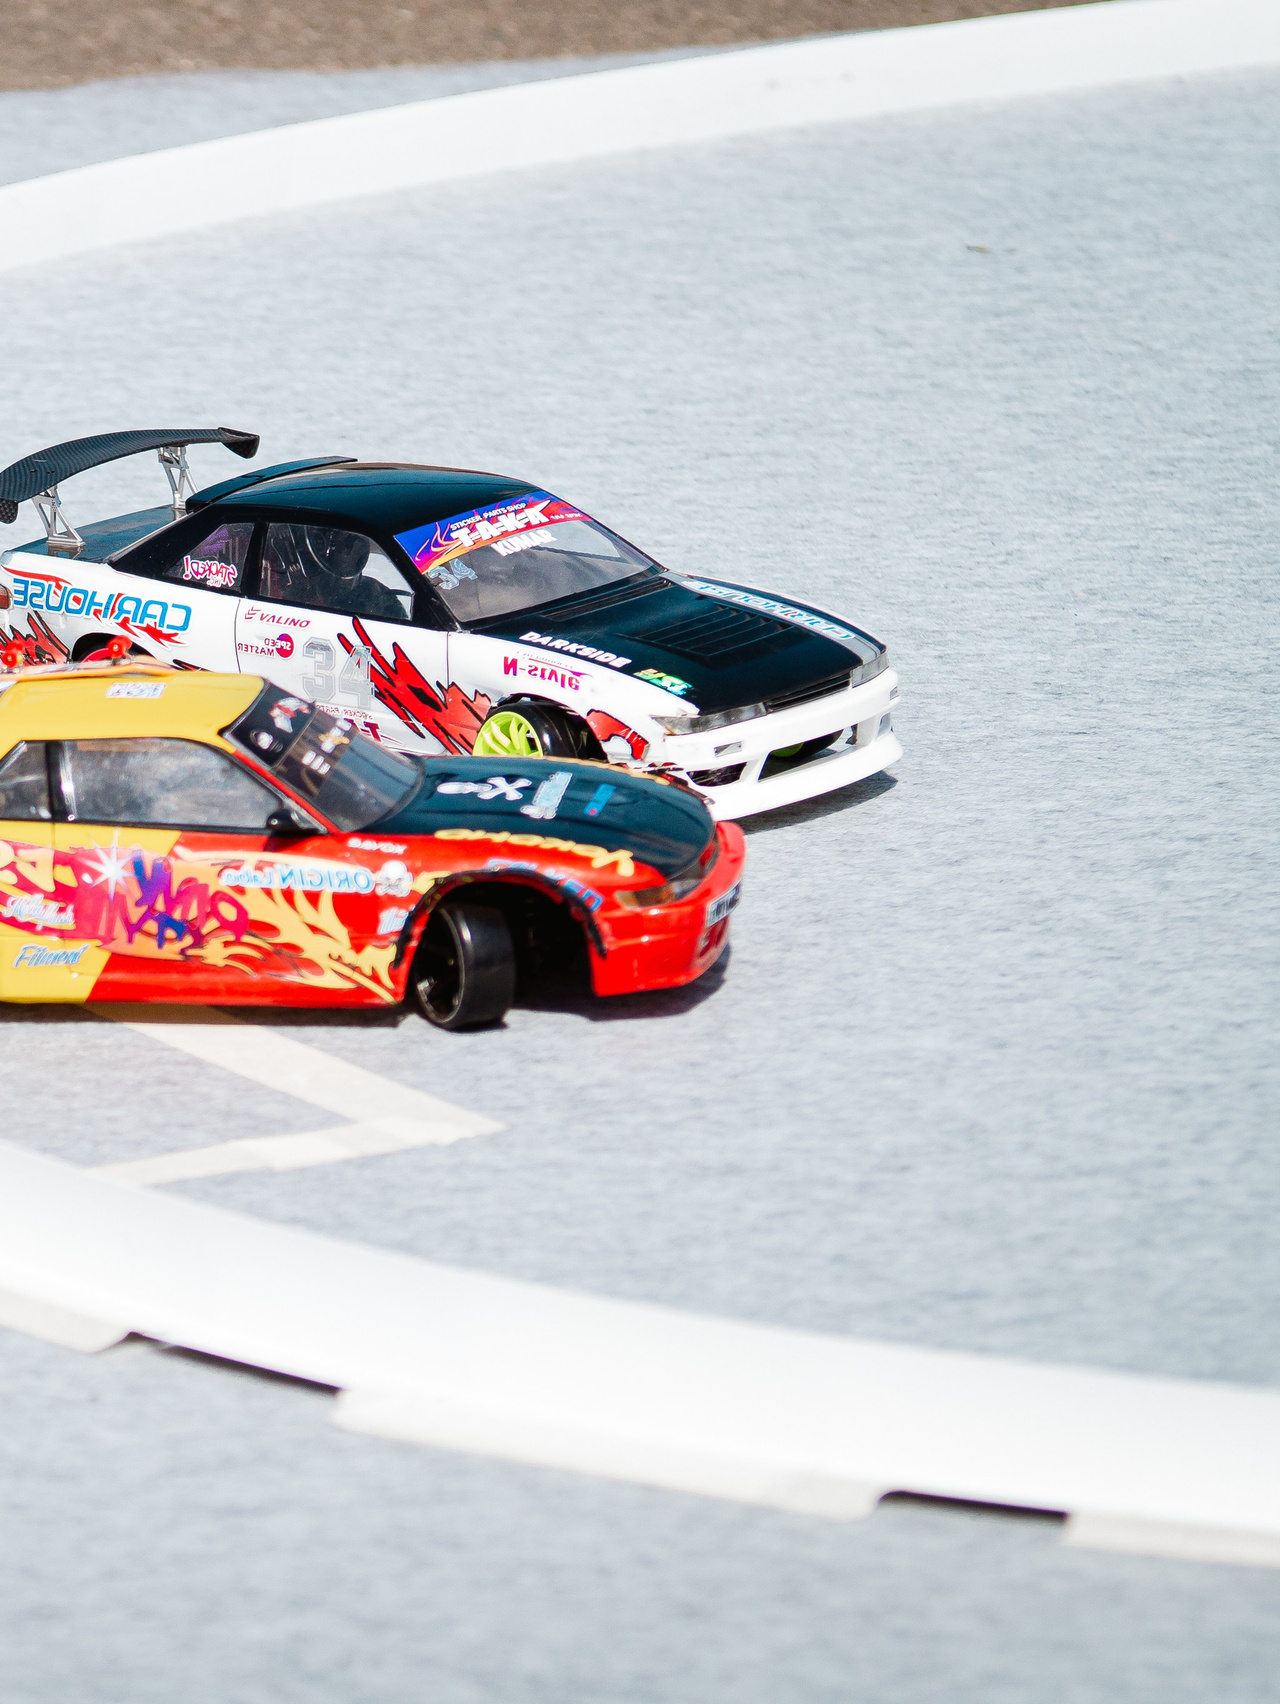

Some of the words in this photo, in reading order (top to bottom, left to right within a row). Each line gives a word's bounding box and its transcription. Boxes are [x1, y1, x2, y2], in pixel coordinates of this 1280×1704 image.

[450, 515, 482, 531] STICKER
[483, 506, 507, 519] PARTS
[506, 502, 527, 513] SHOP
[490, 529, 557, 557] KUMAR
[428, 558, 478, 590] 34
[259, 613, 311, 629] VALINO
[519, 631, 633, 668] DARKSIDE
[303, 637, 376, 708] 34
